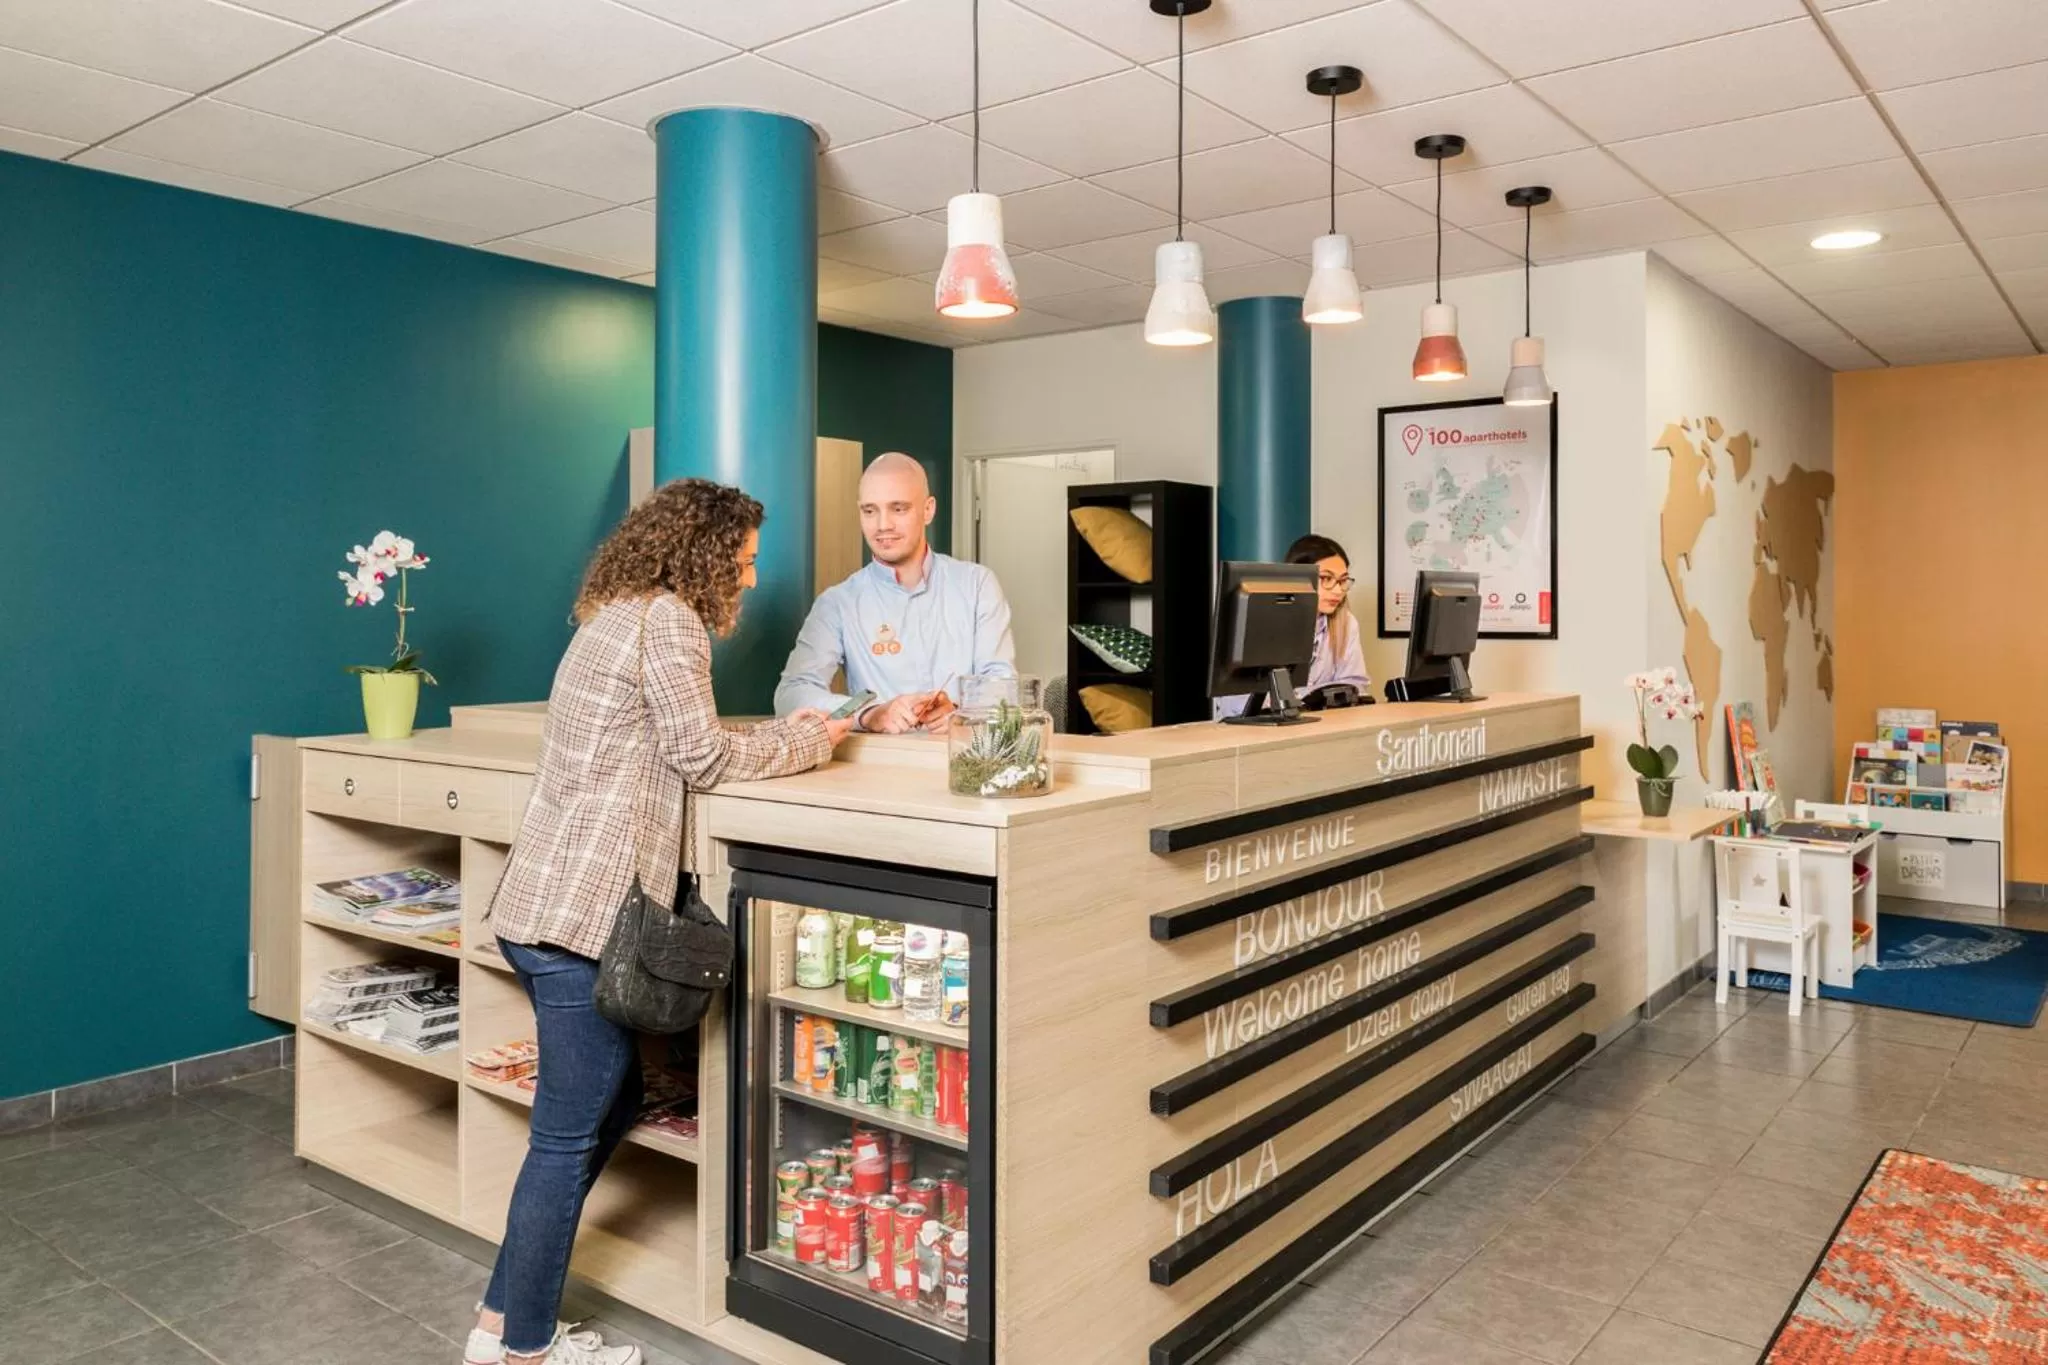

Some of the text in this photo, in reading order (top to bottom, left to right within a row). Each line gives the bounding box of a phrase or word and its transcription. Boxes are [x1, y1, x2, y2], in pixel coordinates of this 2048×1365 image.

[1429, 428, 1528, 446] 100 aparthotels
[1376, 718, 1486, 775] Sanibonani
[1479, 760, 1569, 813] NAMASTE
[1205, 815, 1356, 885] BIENVENUE
[1233, 870, 1386, 969] BONJOUR
[1203, 931, 1421, 1059] Welcome home
[1410, 971, 1457, 1022] dobry
[1176, 1139, 1279, 1237] HOLA
